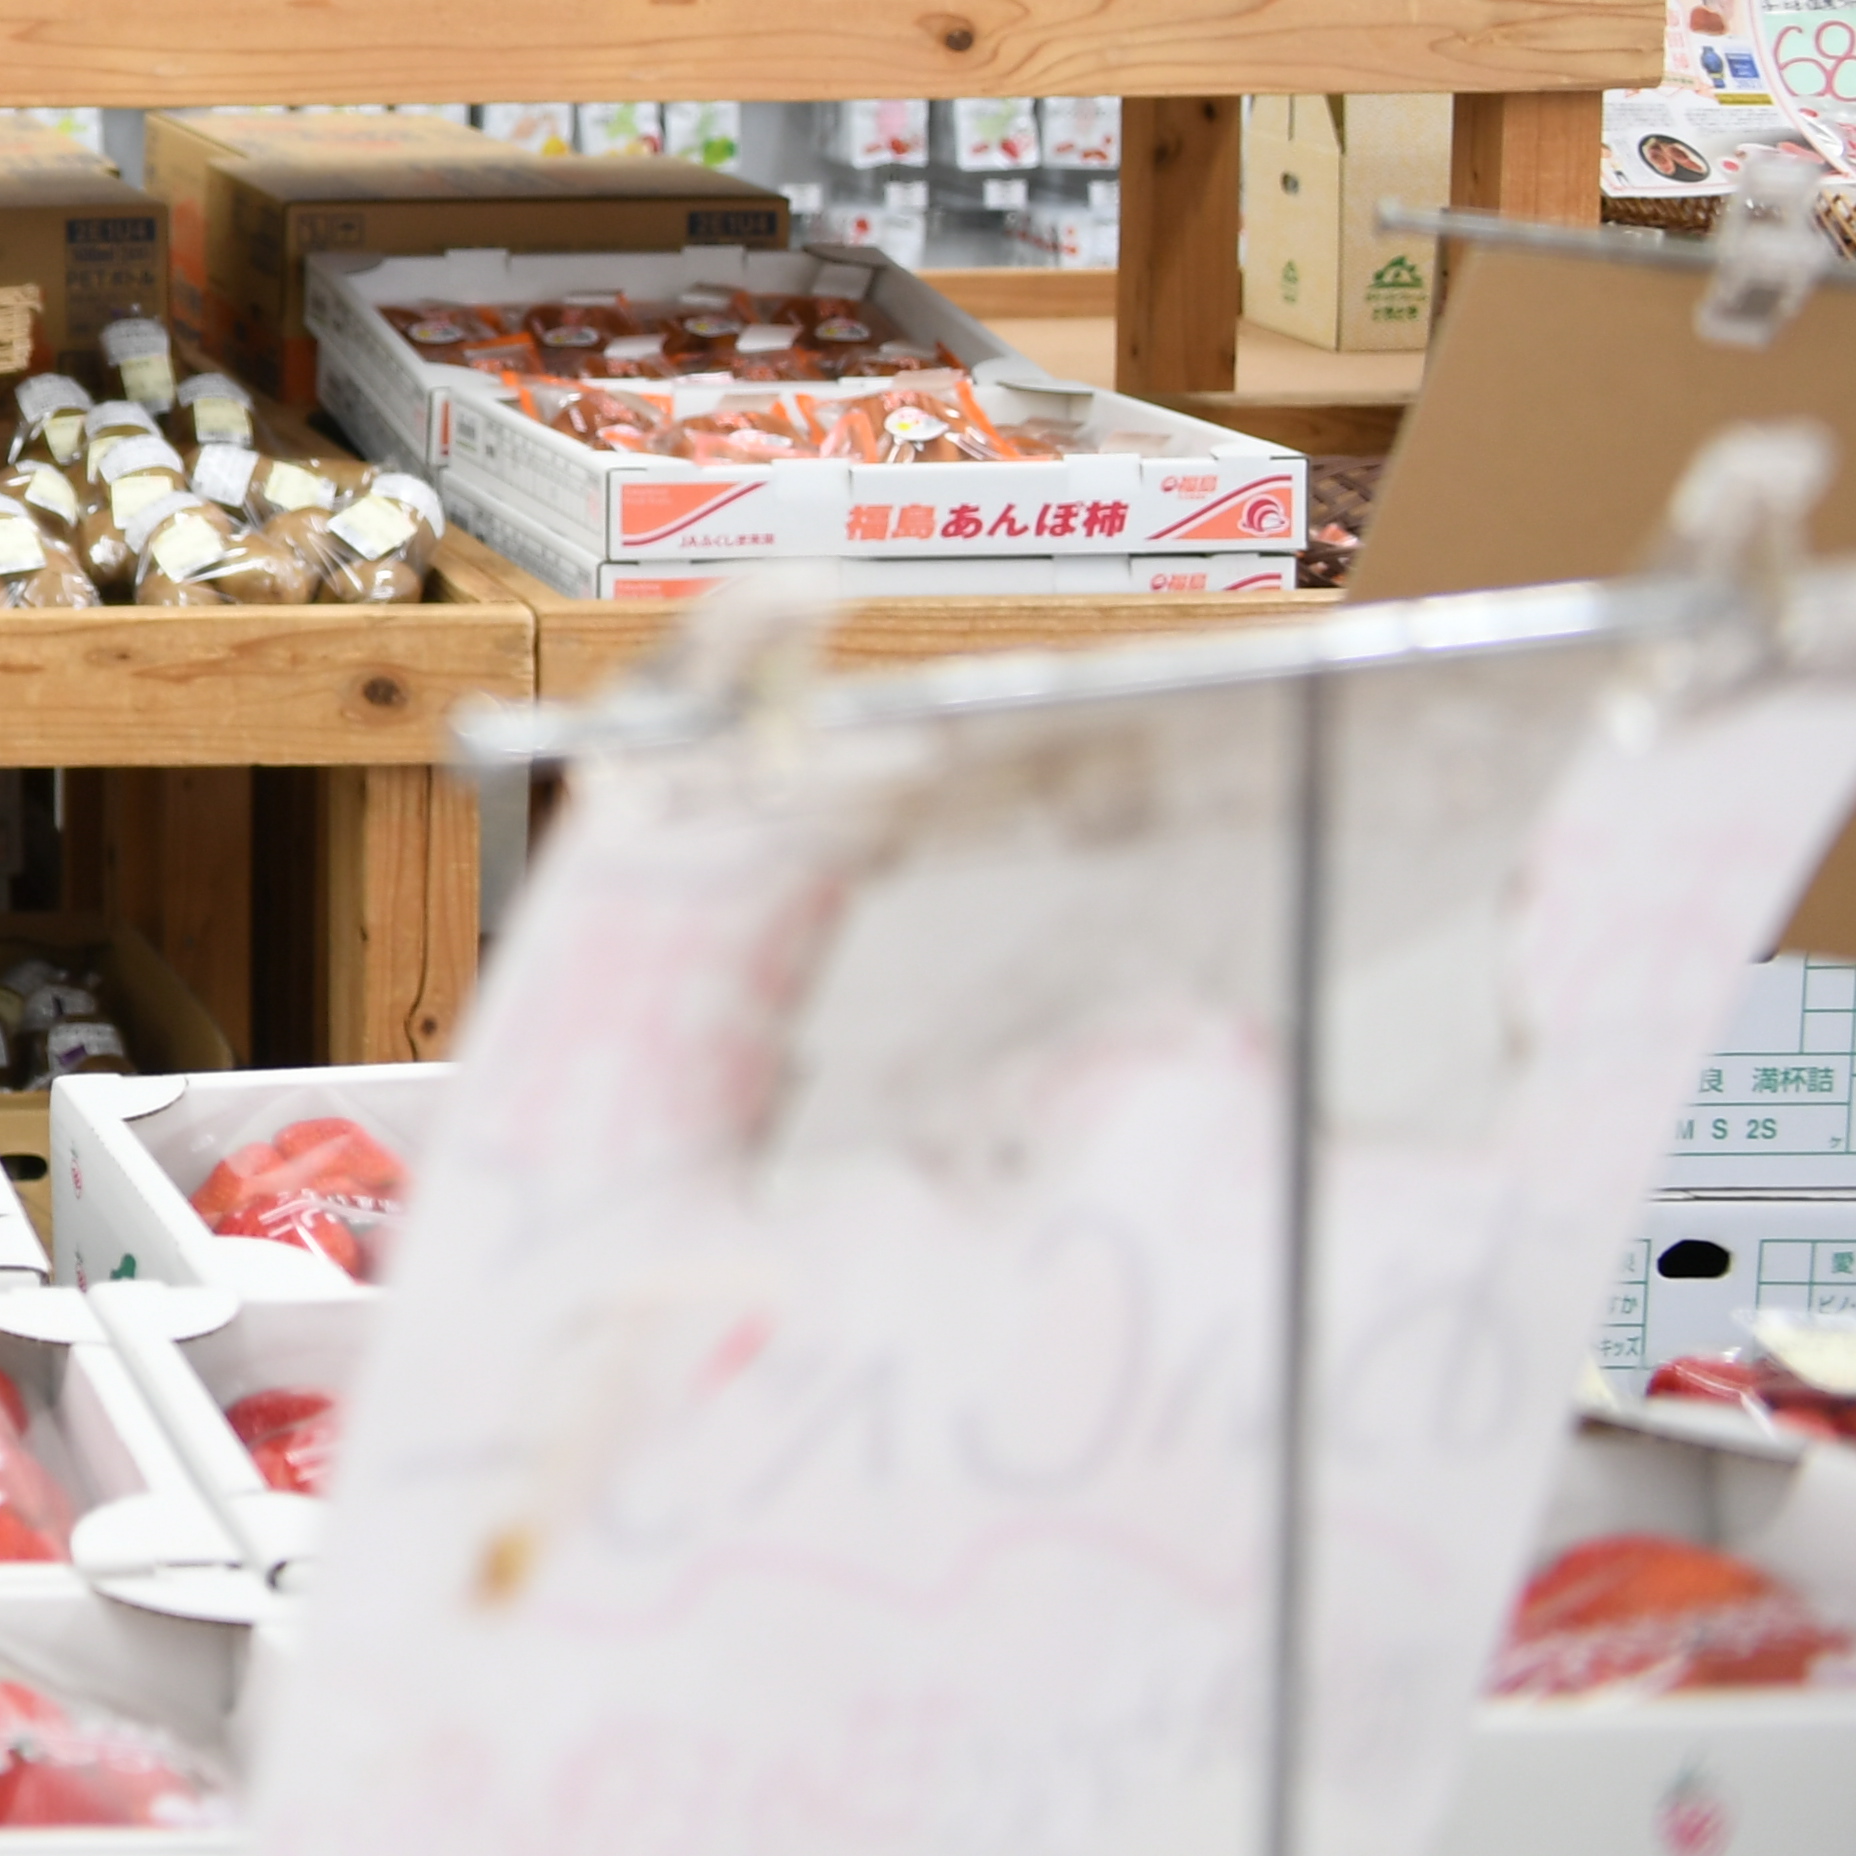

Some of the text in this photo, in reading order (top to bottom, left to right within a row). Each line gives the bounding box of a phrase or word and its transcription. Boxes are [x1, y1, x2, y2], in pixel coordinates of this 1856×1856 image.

[845, 501, 1129, 542] 福島あんぽ柿
[1751, 1066, 1835, 1095] 満杯詰
[1711, 1118, 1729, 1141] S
[1746, 1118, 1778, 1141] 2S
